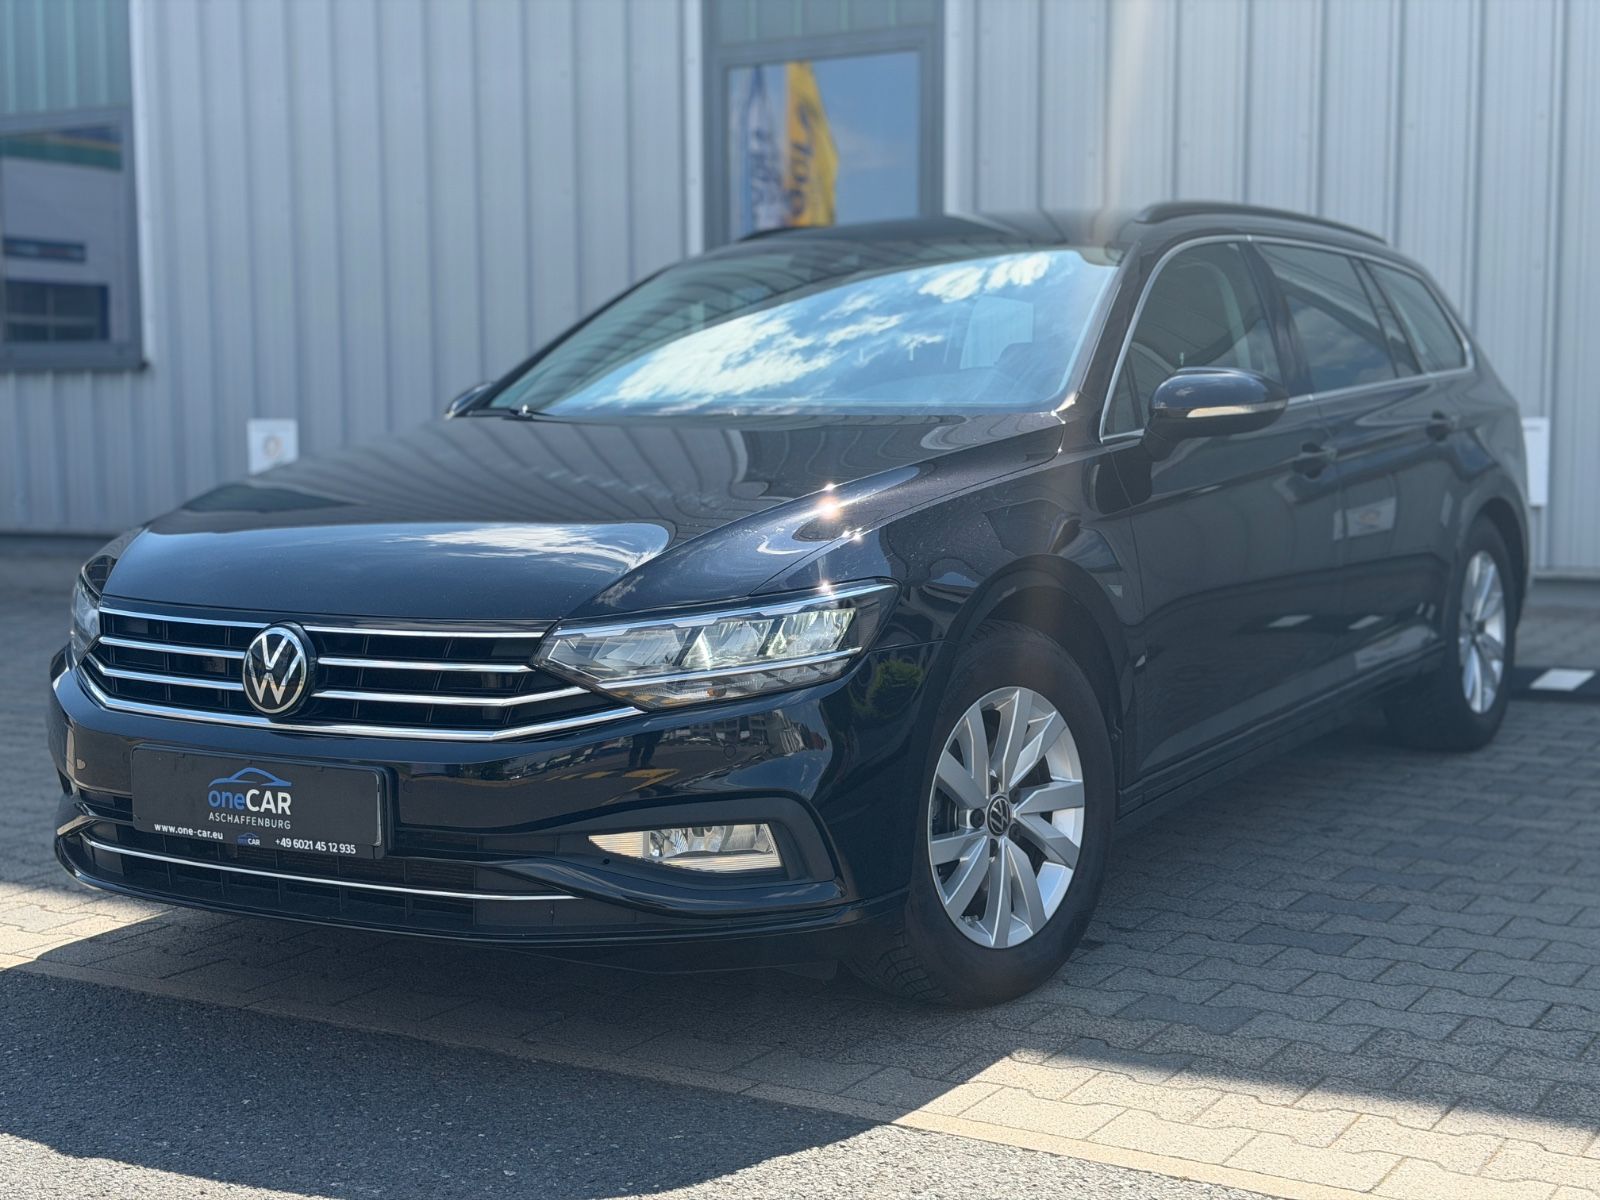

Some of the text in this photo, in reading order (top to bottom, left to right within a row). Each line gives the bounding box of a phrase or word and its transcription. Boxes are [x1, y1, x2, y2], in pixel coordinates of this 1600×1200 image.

[246, 631, 304, 709] VW
[208, 788, 292, 815] oneCAR
[208, 811, 291, 830] ASCHAFFENBURG
[154, 823, 224, 840] www.one-car.eu
[275, 837, 356, 855] +49 6021 45 12 935
